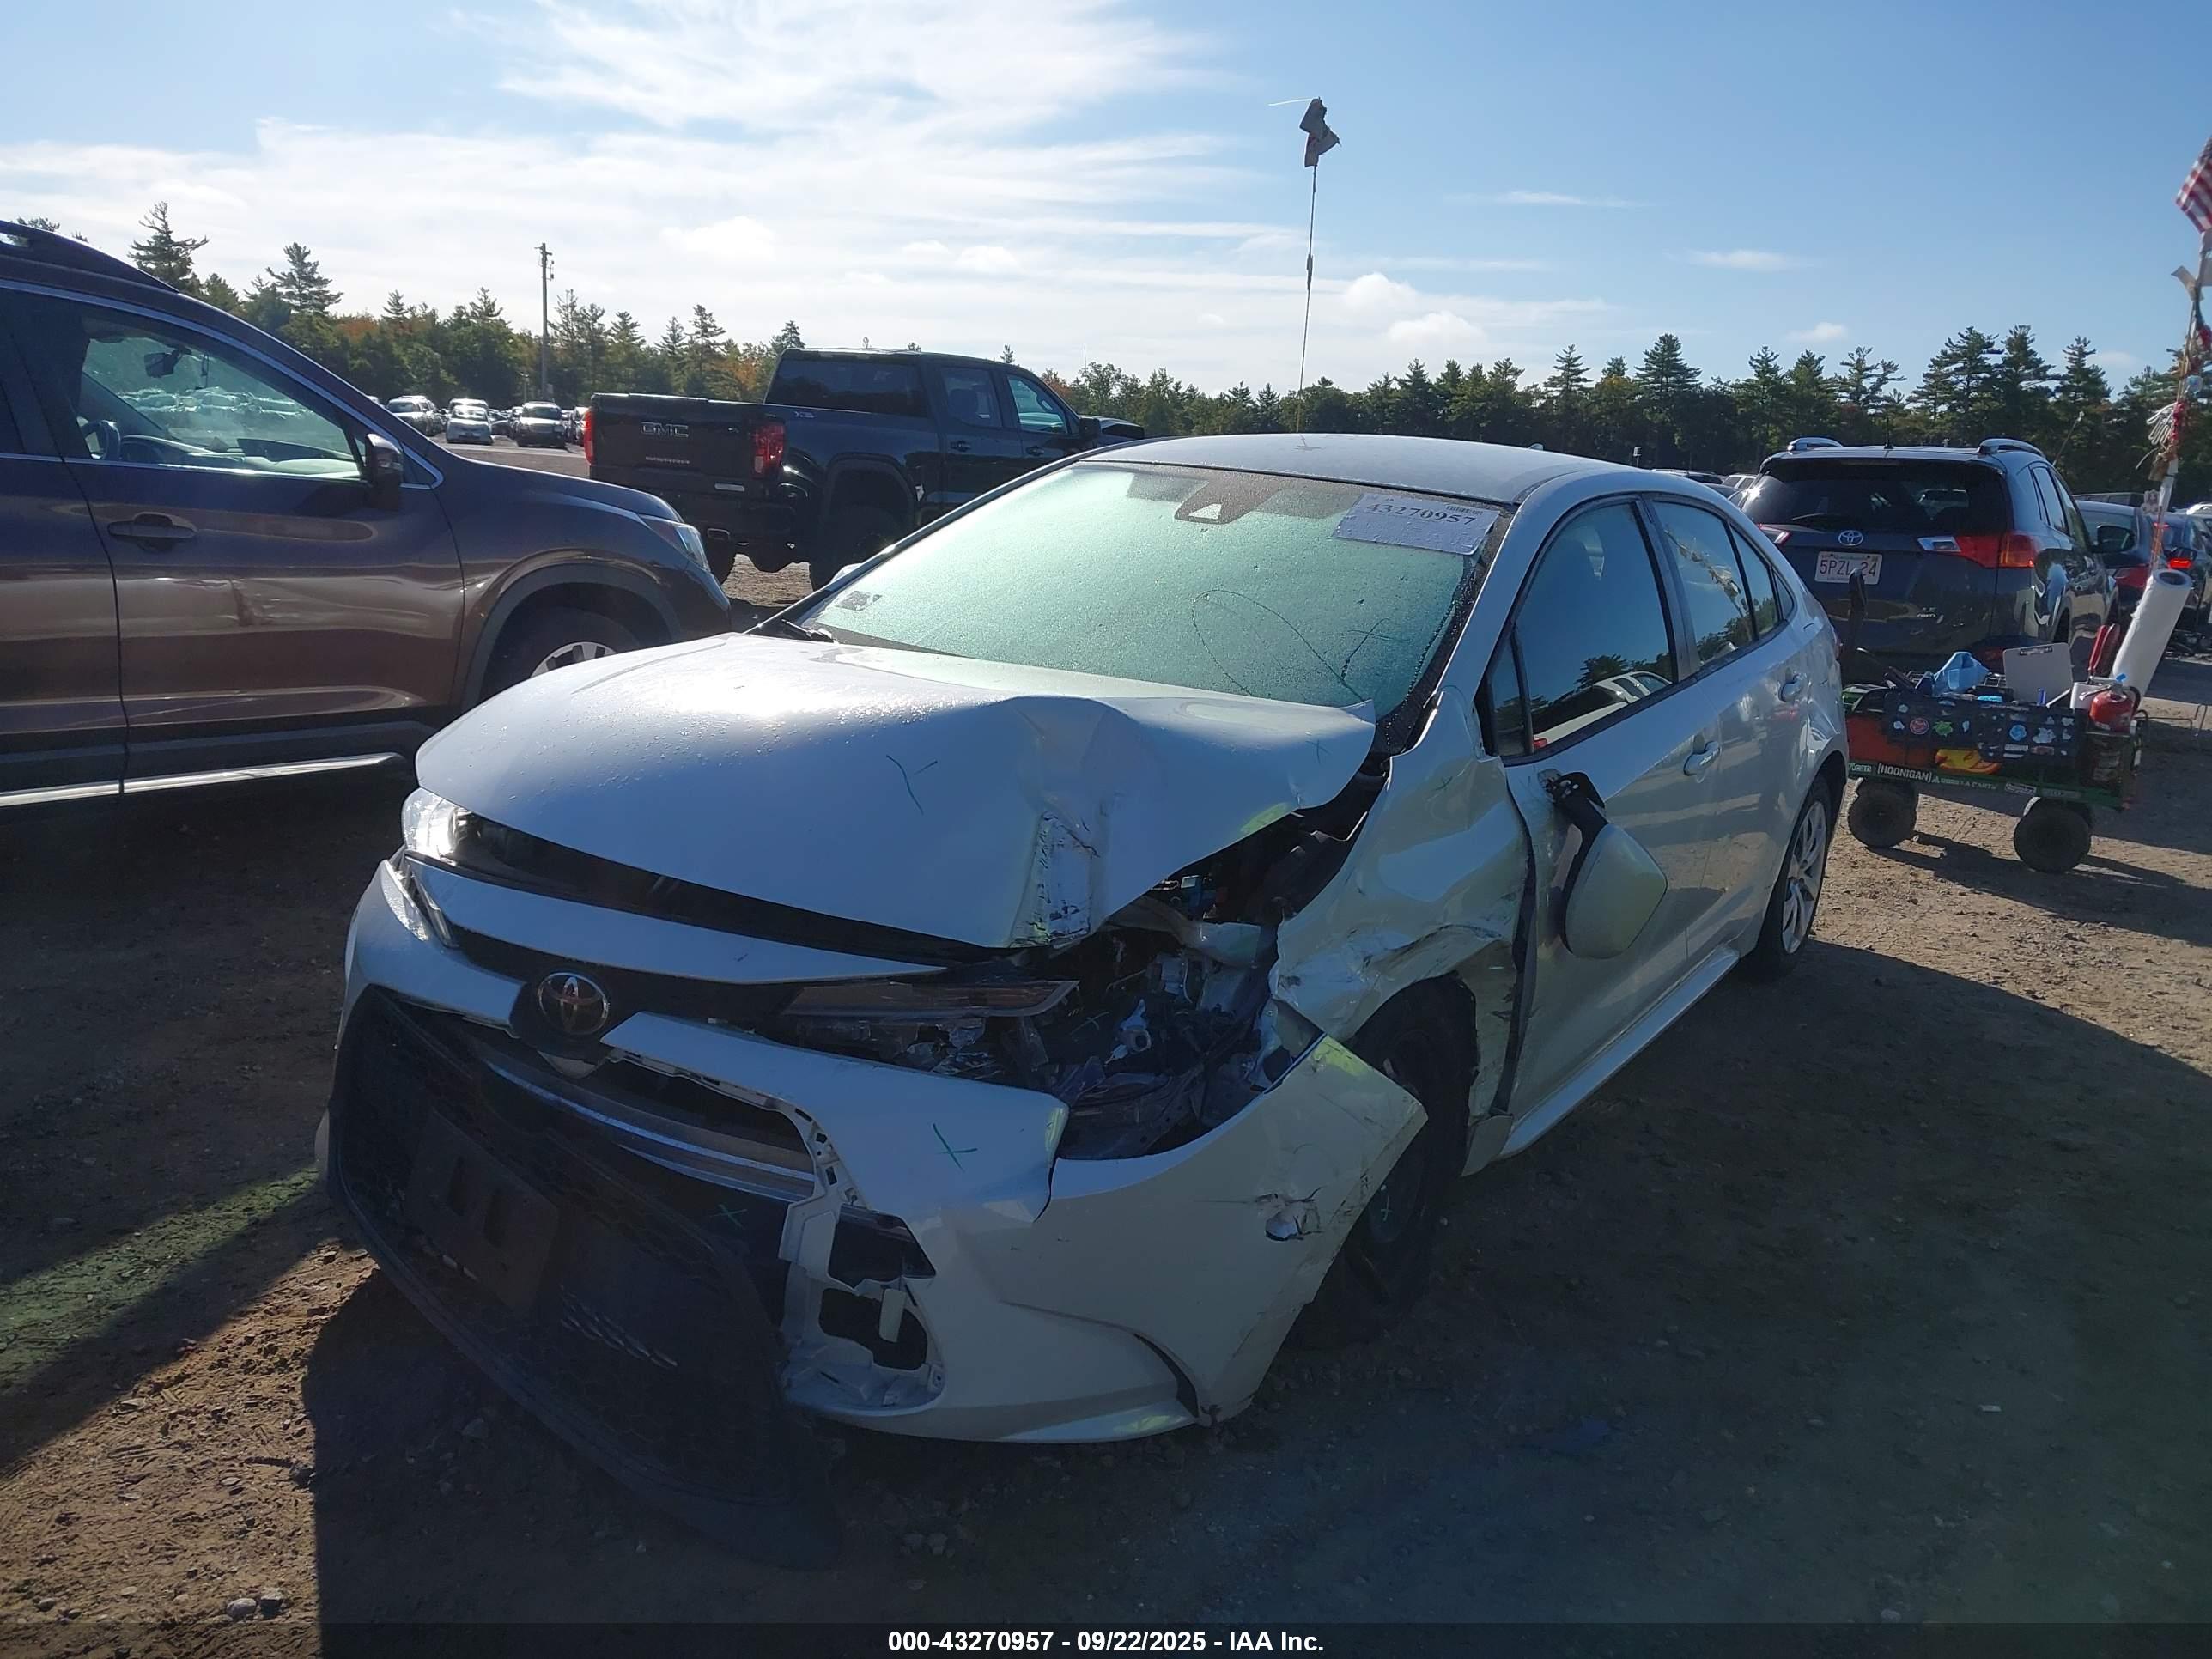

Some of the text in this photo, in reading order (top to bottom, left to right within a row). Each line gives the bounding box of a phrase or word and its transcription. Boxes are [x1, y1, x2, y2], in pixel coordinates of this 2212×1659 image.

[641, 422, 689, 437] GMC
[1366, 503, 1477, 526] 43270957
[1820, 559, 1877, 577] 5PZL 24
